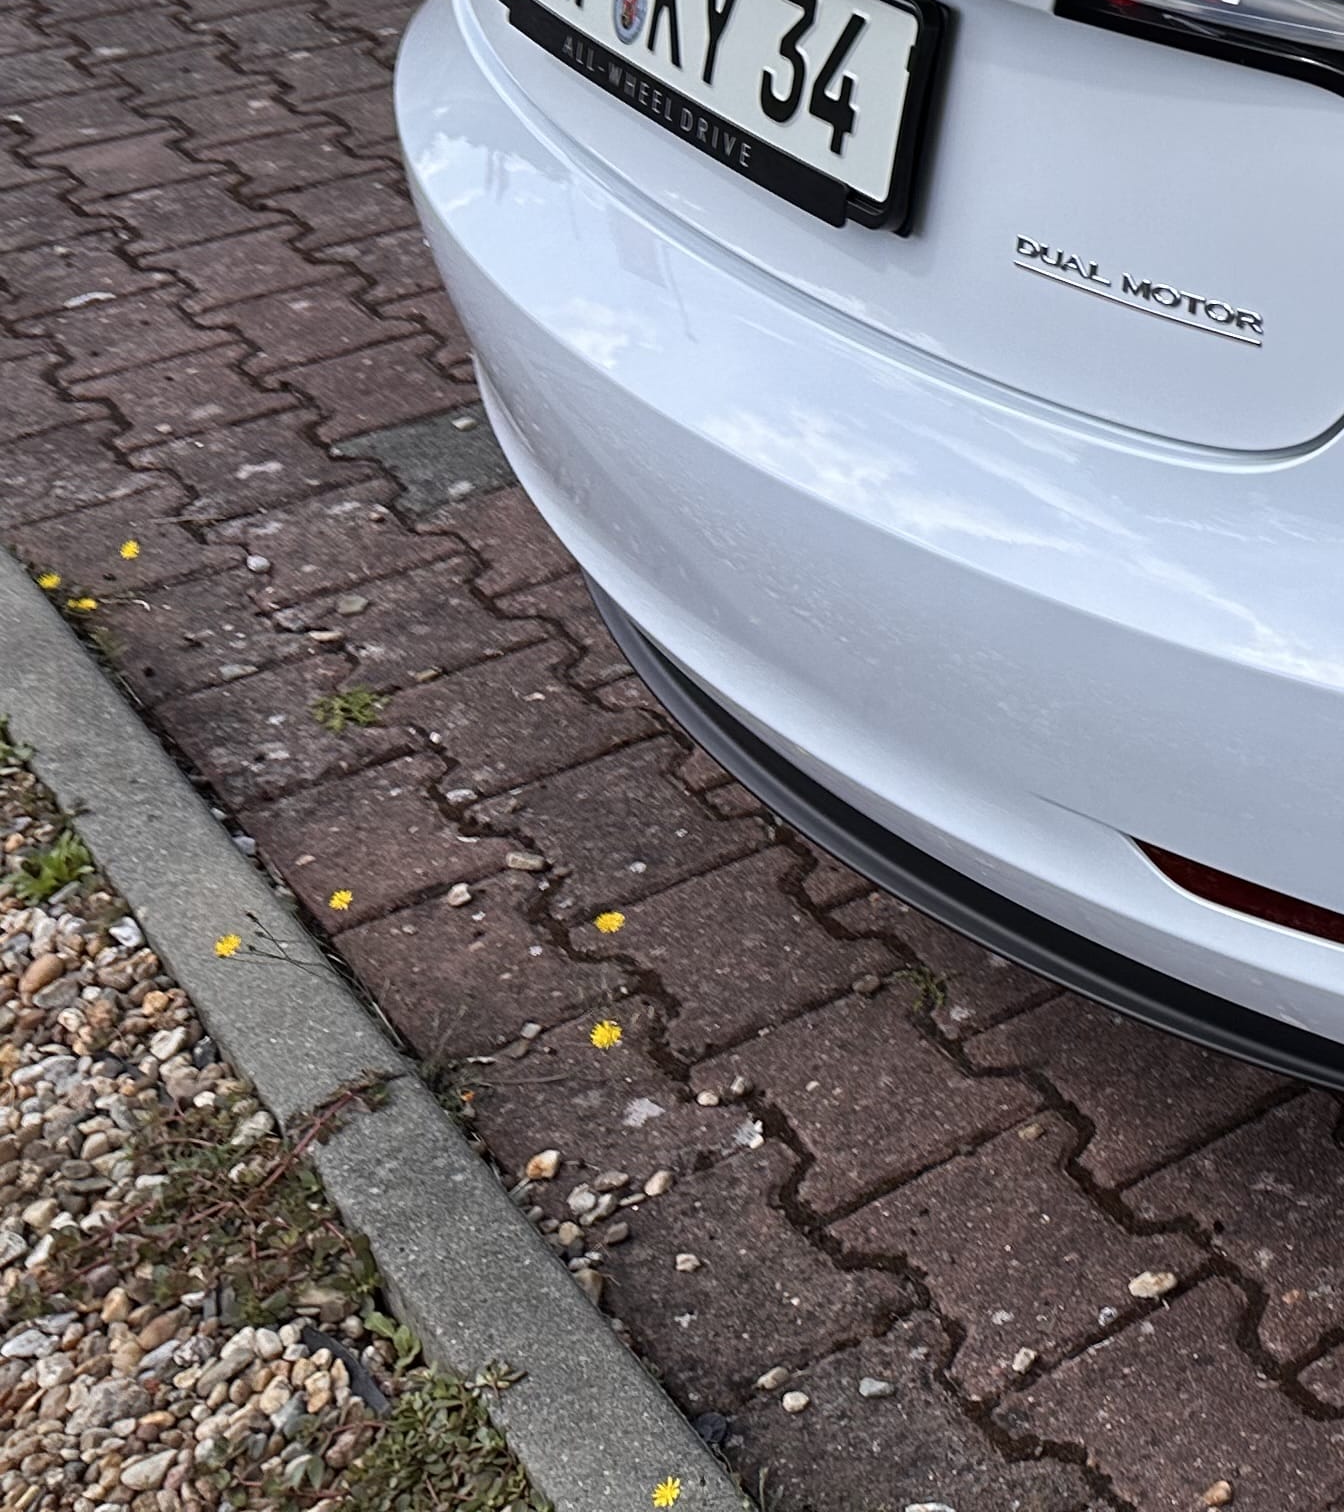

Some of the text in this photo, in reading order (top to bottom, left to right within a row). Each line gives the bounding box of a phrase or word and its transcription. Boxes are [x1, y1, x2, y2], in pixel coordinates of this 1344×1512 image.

[562, 35, 752, 168] ALL-WHEEL DRIVE
[1016, 234, 1264, 334] DUAL MOTOR
